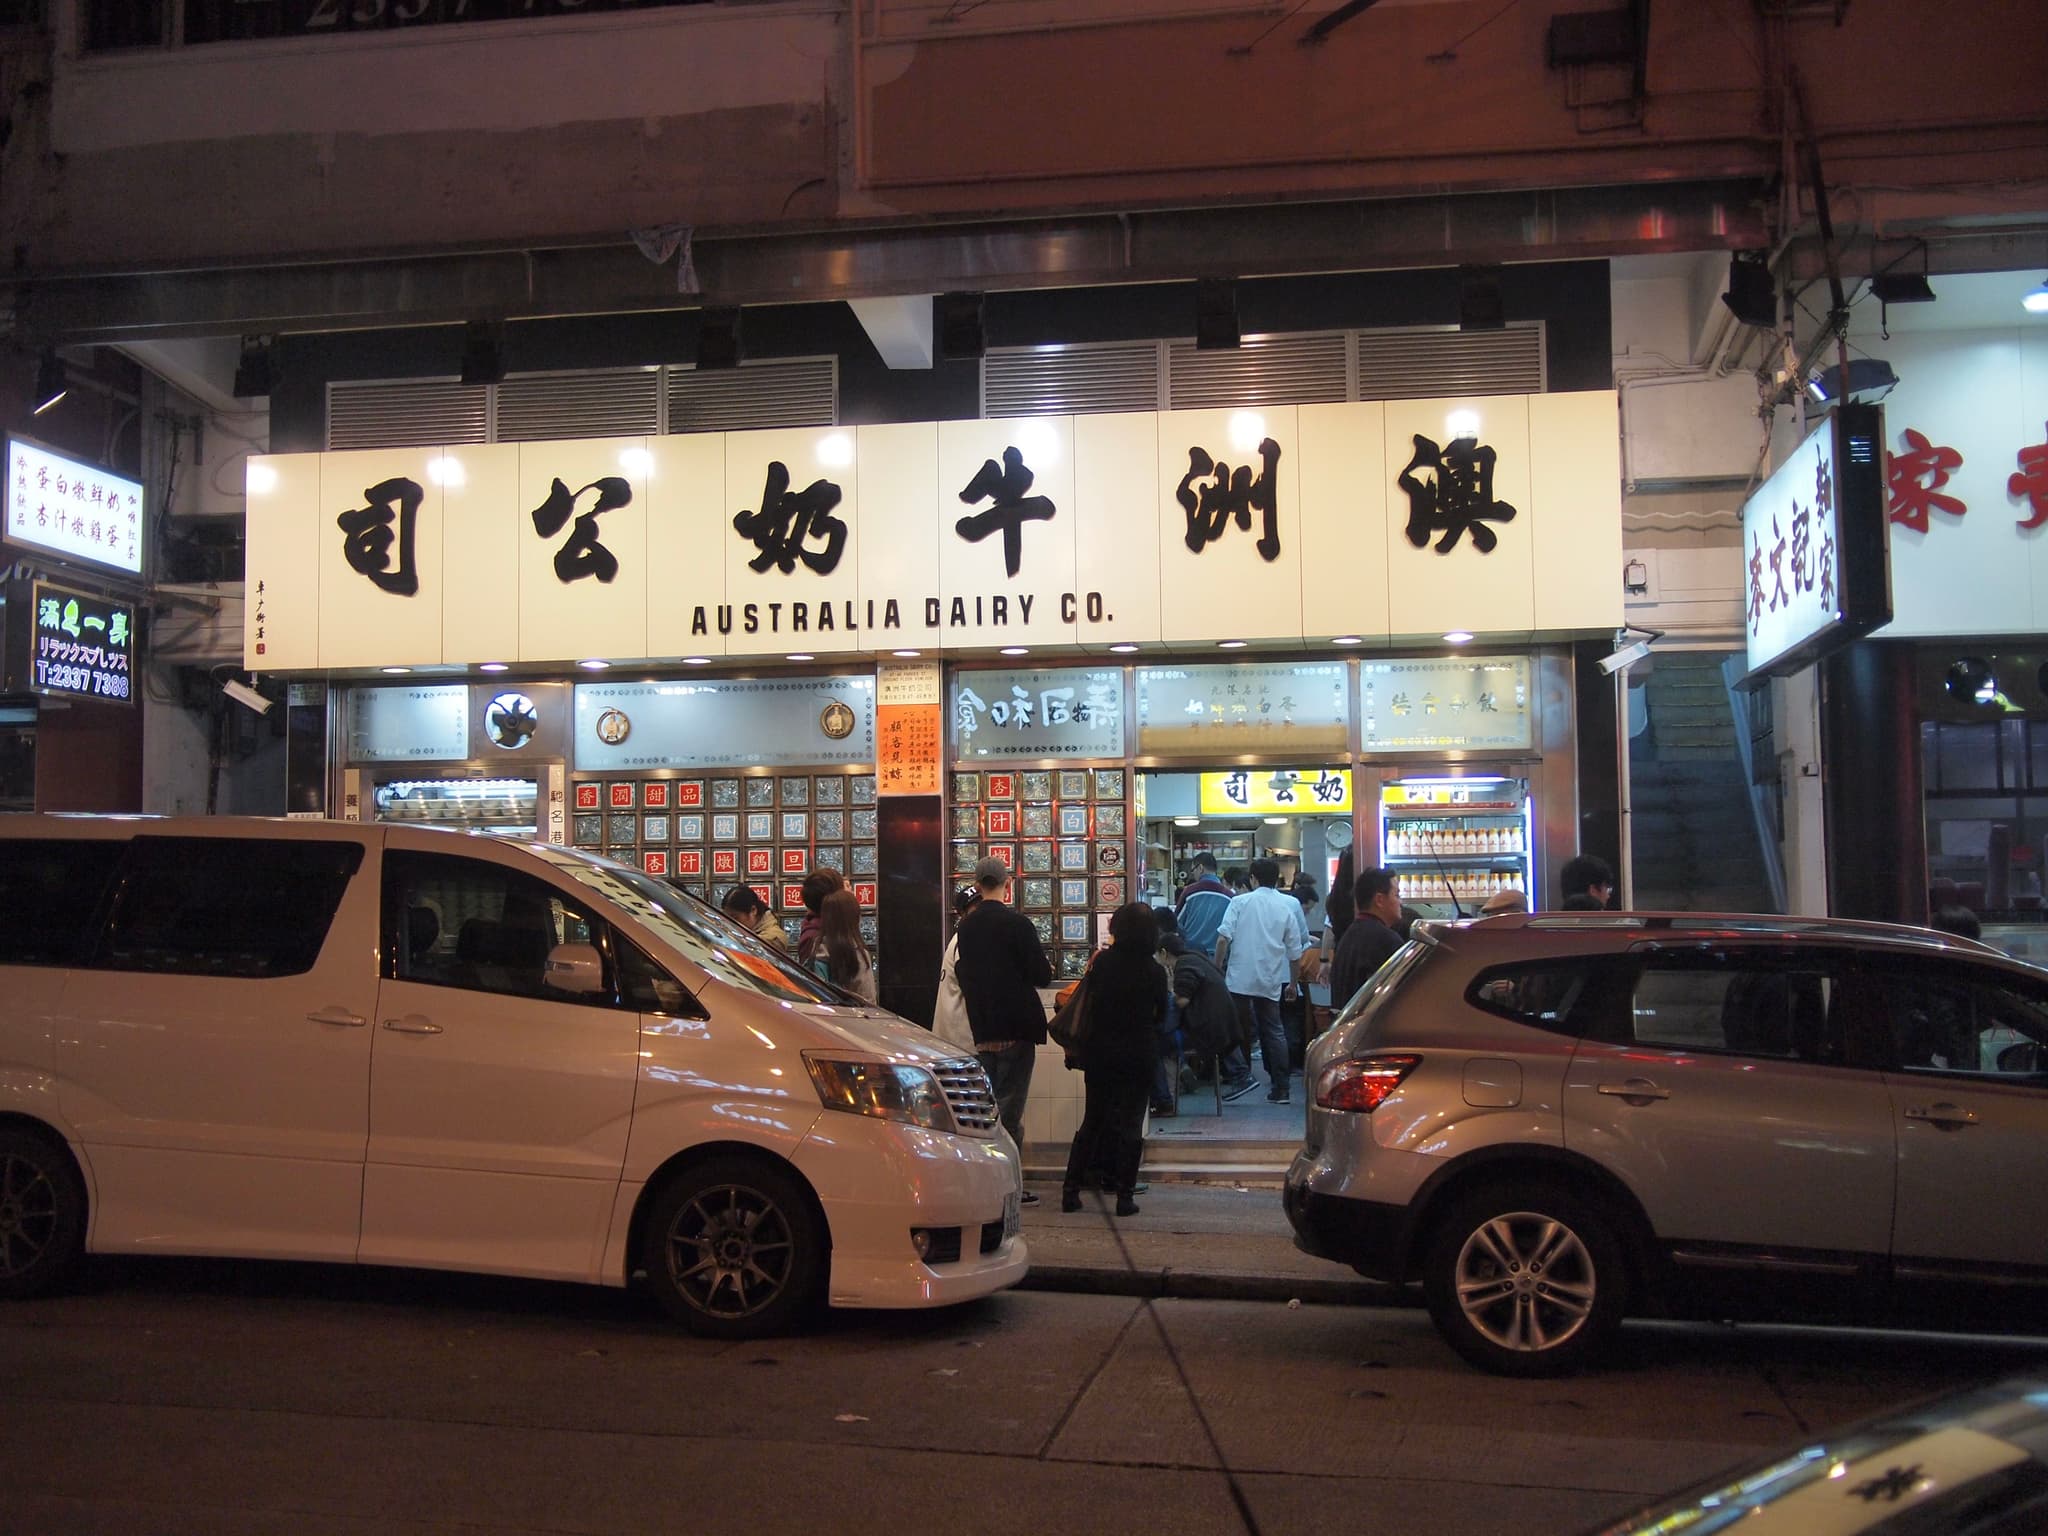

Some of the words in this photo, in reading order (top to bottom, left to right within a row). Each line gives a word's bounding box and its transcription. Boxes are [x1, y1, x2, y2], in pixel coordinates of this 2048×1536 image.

[337, 433, 1517, 597] 澳洲牛奶公司
[691, 598, 900, 636] AUSTRALIA
[925, 594, 1034, 628] DAIRY
[1061, 591, 1113, 624] CO.
[37, 660, 90, 691] T:2337
[93, 671, 129, 698] 7388
[580, 787, 698, 805] 香潤甜品
